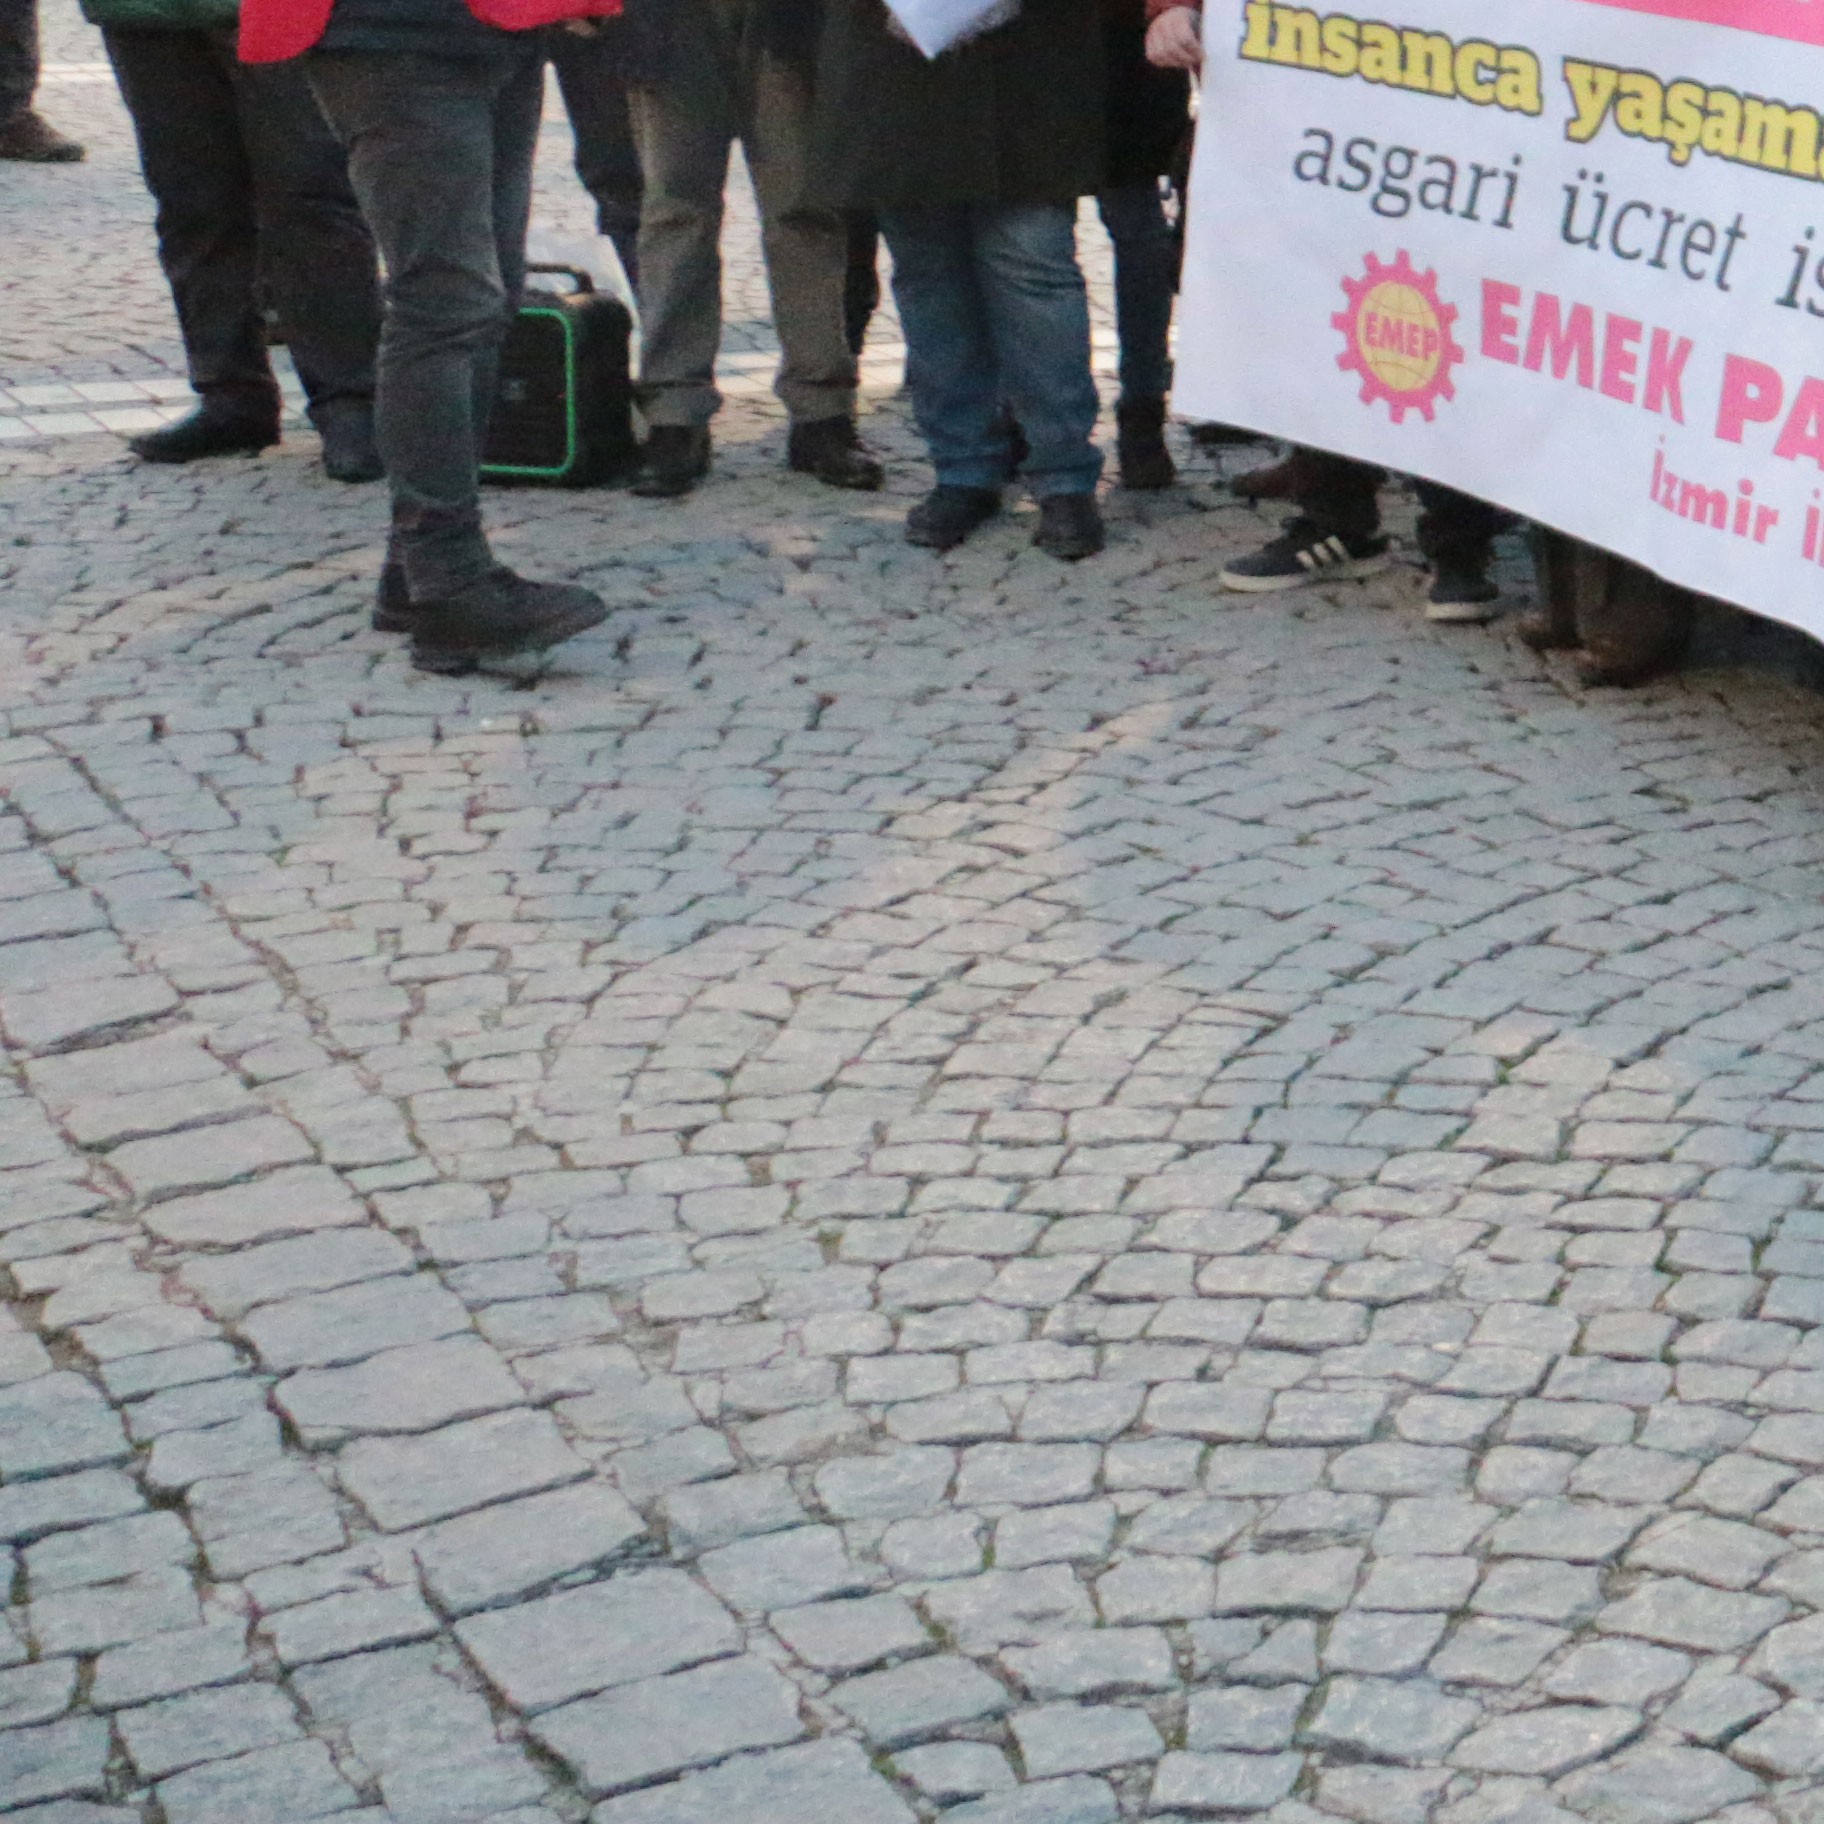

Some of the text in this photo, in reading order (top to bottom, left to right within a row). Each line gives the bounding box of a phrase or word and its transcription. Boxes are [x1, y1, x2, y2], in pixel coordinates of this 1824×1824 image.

[1293, 125, 1524, 231] asgari
[1560, 167, 1747, 292] ücret
[1363, 311, 1440, 362] EMEP
[1481, 278, 1694, 426] EMEK
[1650, 433, 1779, 544] İzmir
